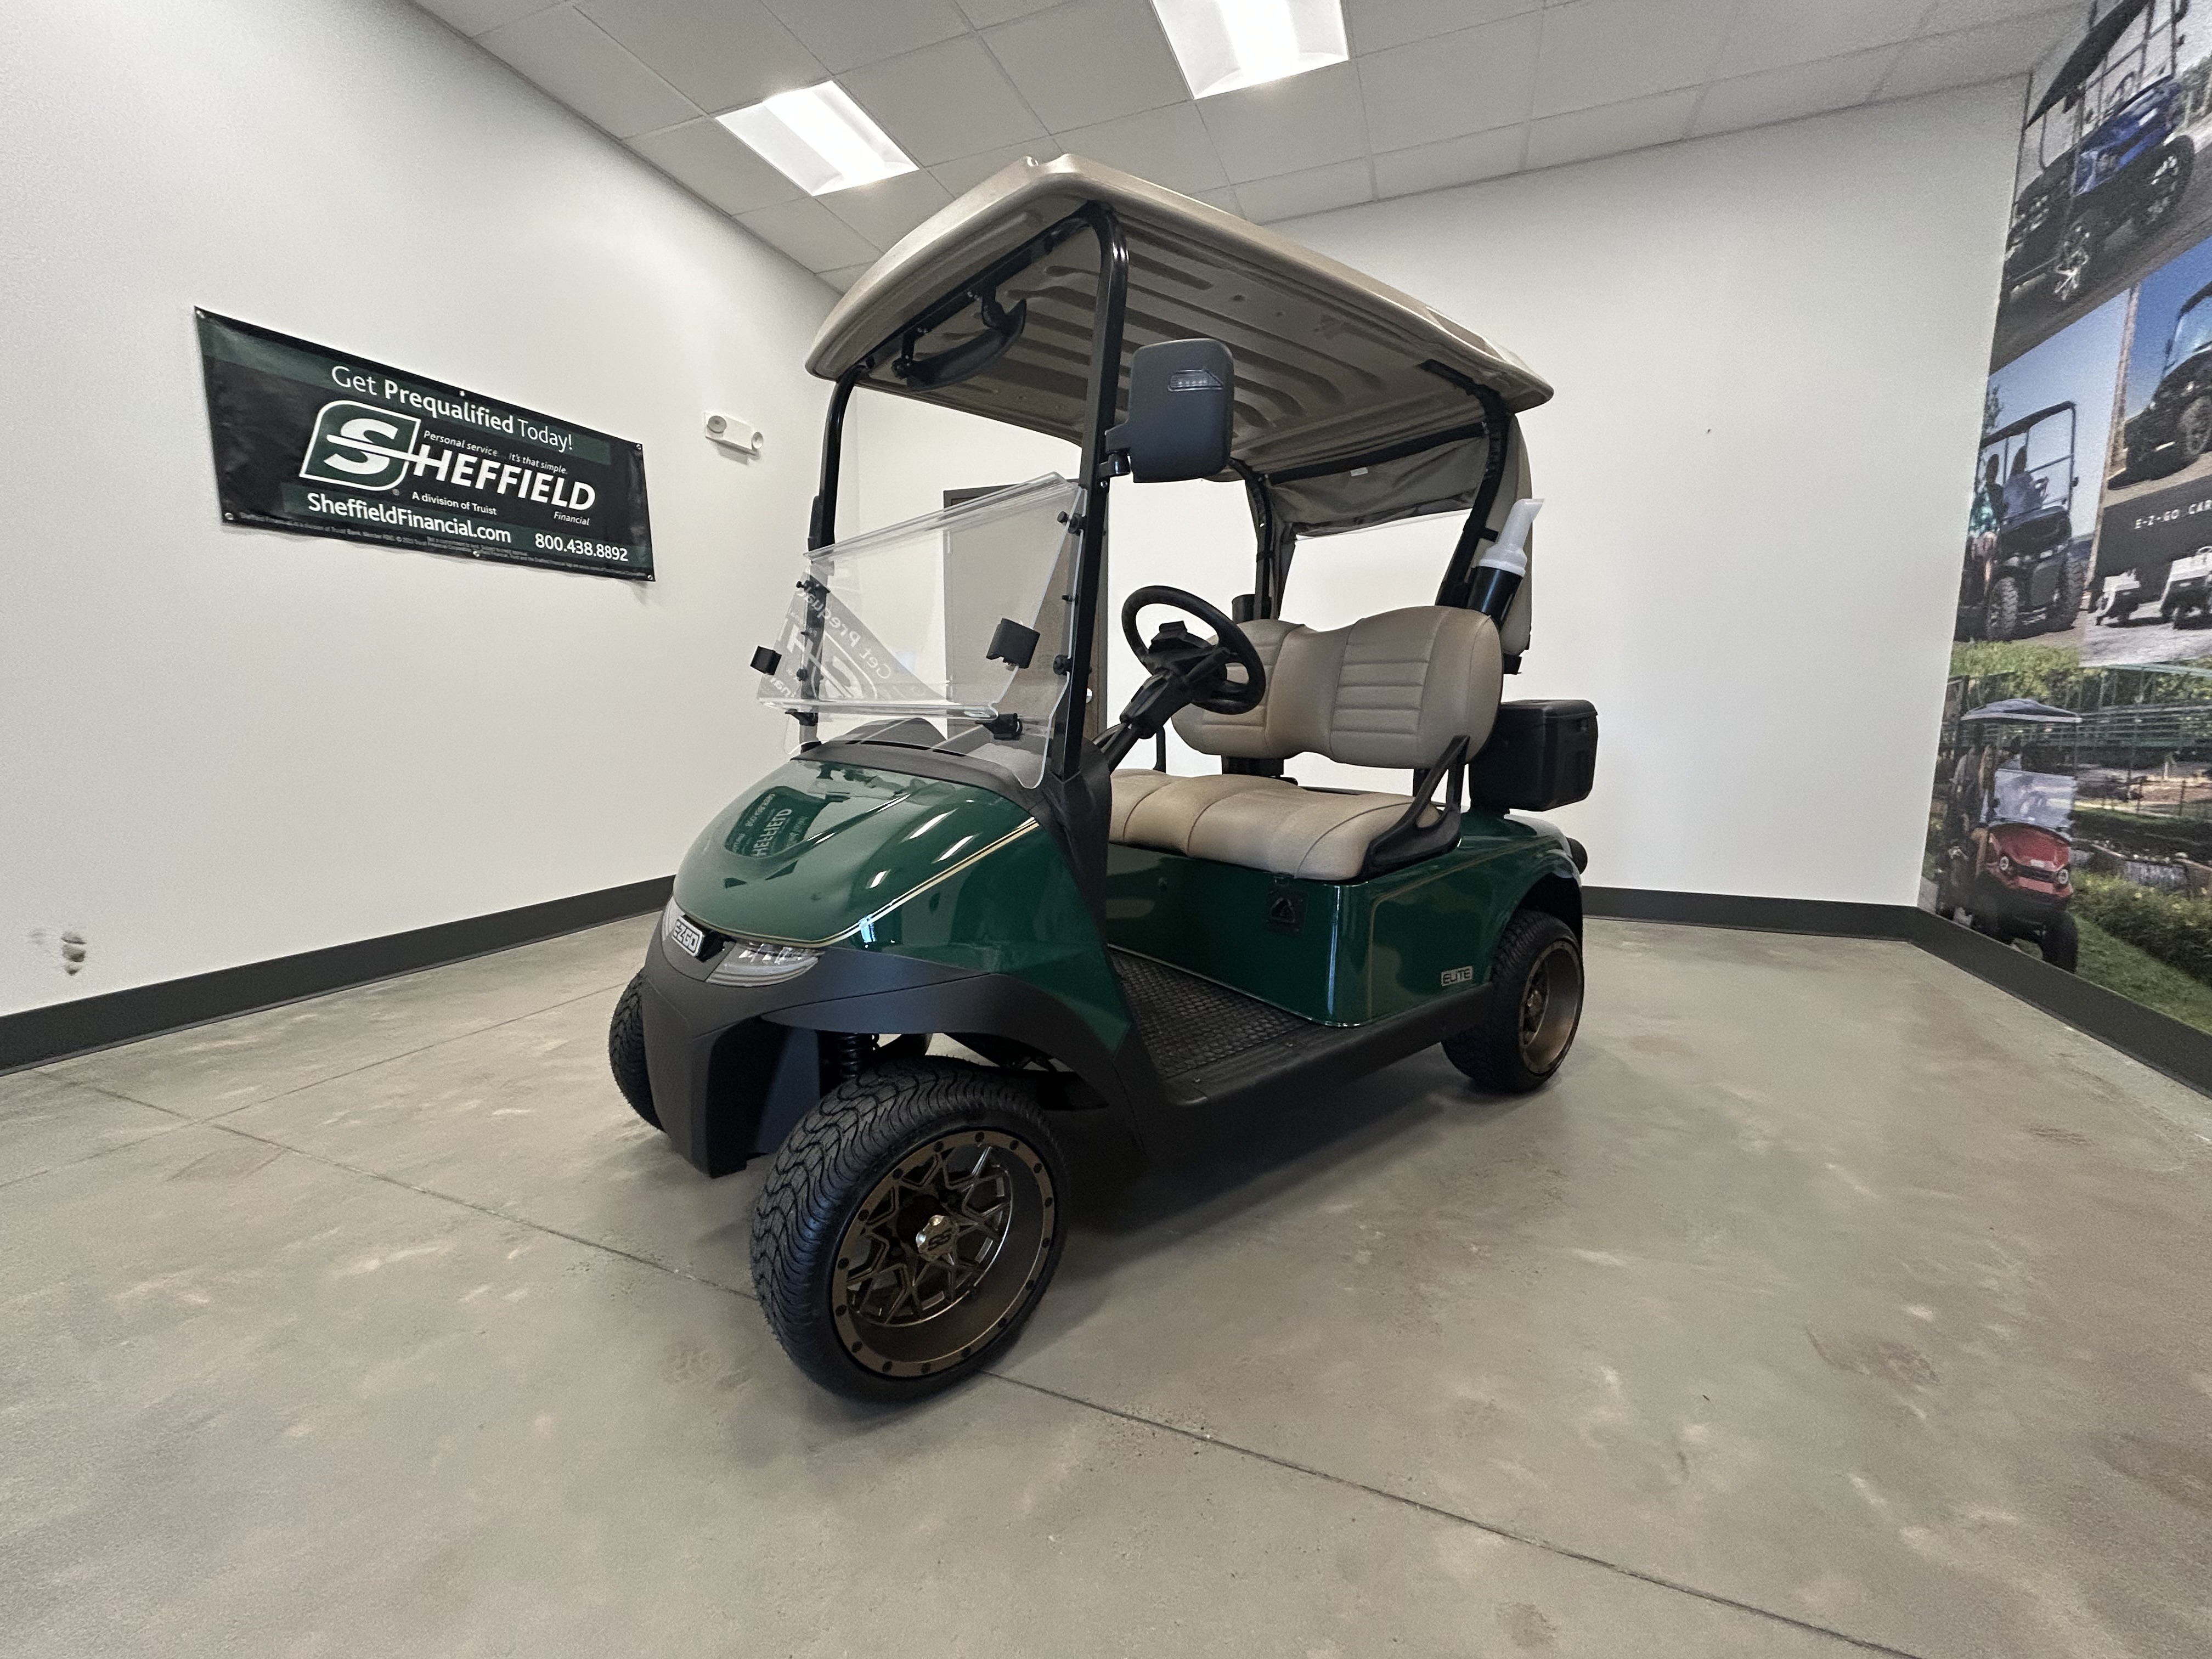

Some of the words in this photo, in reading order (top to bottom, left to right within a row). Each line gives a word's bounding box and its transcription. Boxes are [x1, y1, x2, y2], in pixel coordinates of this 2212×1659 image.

[331, 365, 377, 396] Get
[385, 379, 514, 433] Prequalified
[517, 419, 573, 453] Today!
[424, 430, 465, 448] Personal
[522, 456, 540, 467] that
[307, 492, 511, 543] SheffieldFinancial.com
[412, 492, 420, 501] A
[421, 493, 459, 508] division
[461, 501, 471, 510] of
[471, 503, 497, 515] Truist
[553, 511, 590, 526] Financial
[535, 533, 629, 562] 800.438.8892
